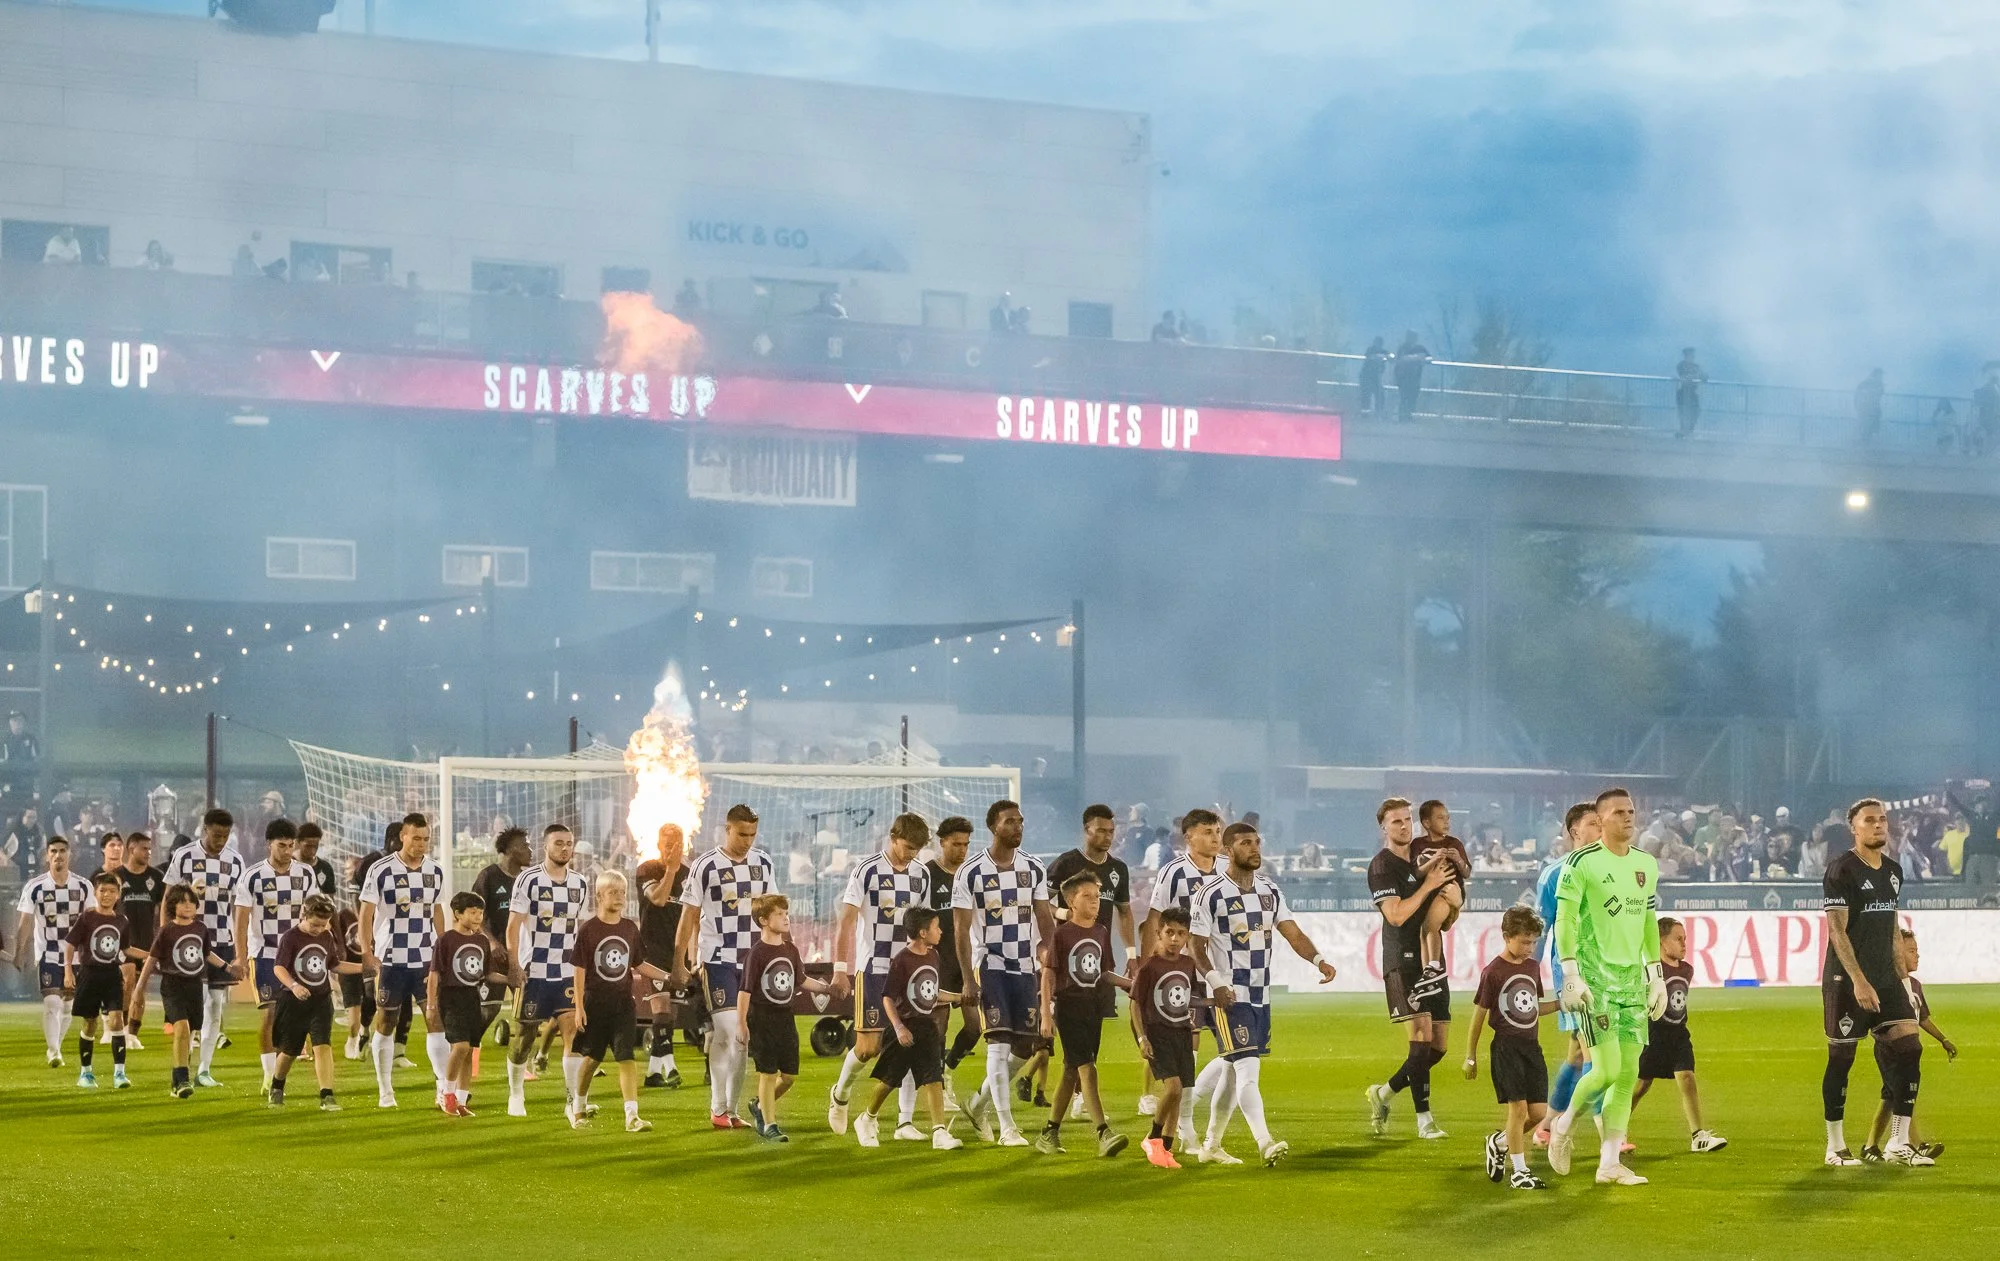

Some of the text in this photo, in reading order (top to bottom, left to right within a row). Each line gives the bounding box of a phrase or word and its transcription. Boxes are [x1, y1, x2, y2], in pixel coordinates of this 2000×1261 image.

[688, 220, 809, 249] KICK & GO
[0, 336, 159, 388] VES UP
[484, 364, 717, 417] SCARVES UP
[996, 395, 1199, 450] SCARVES UP
[1373, 888, 1397, 898] Kiewit
[1625, 897, 1645, 906] Select
